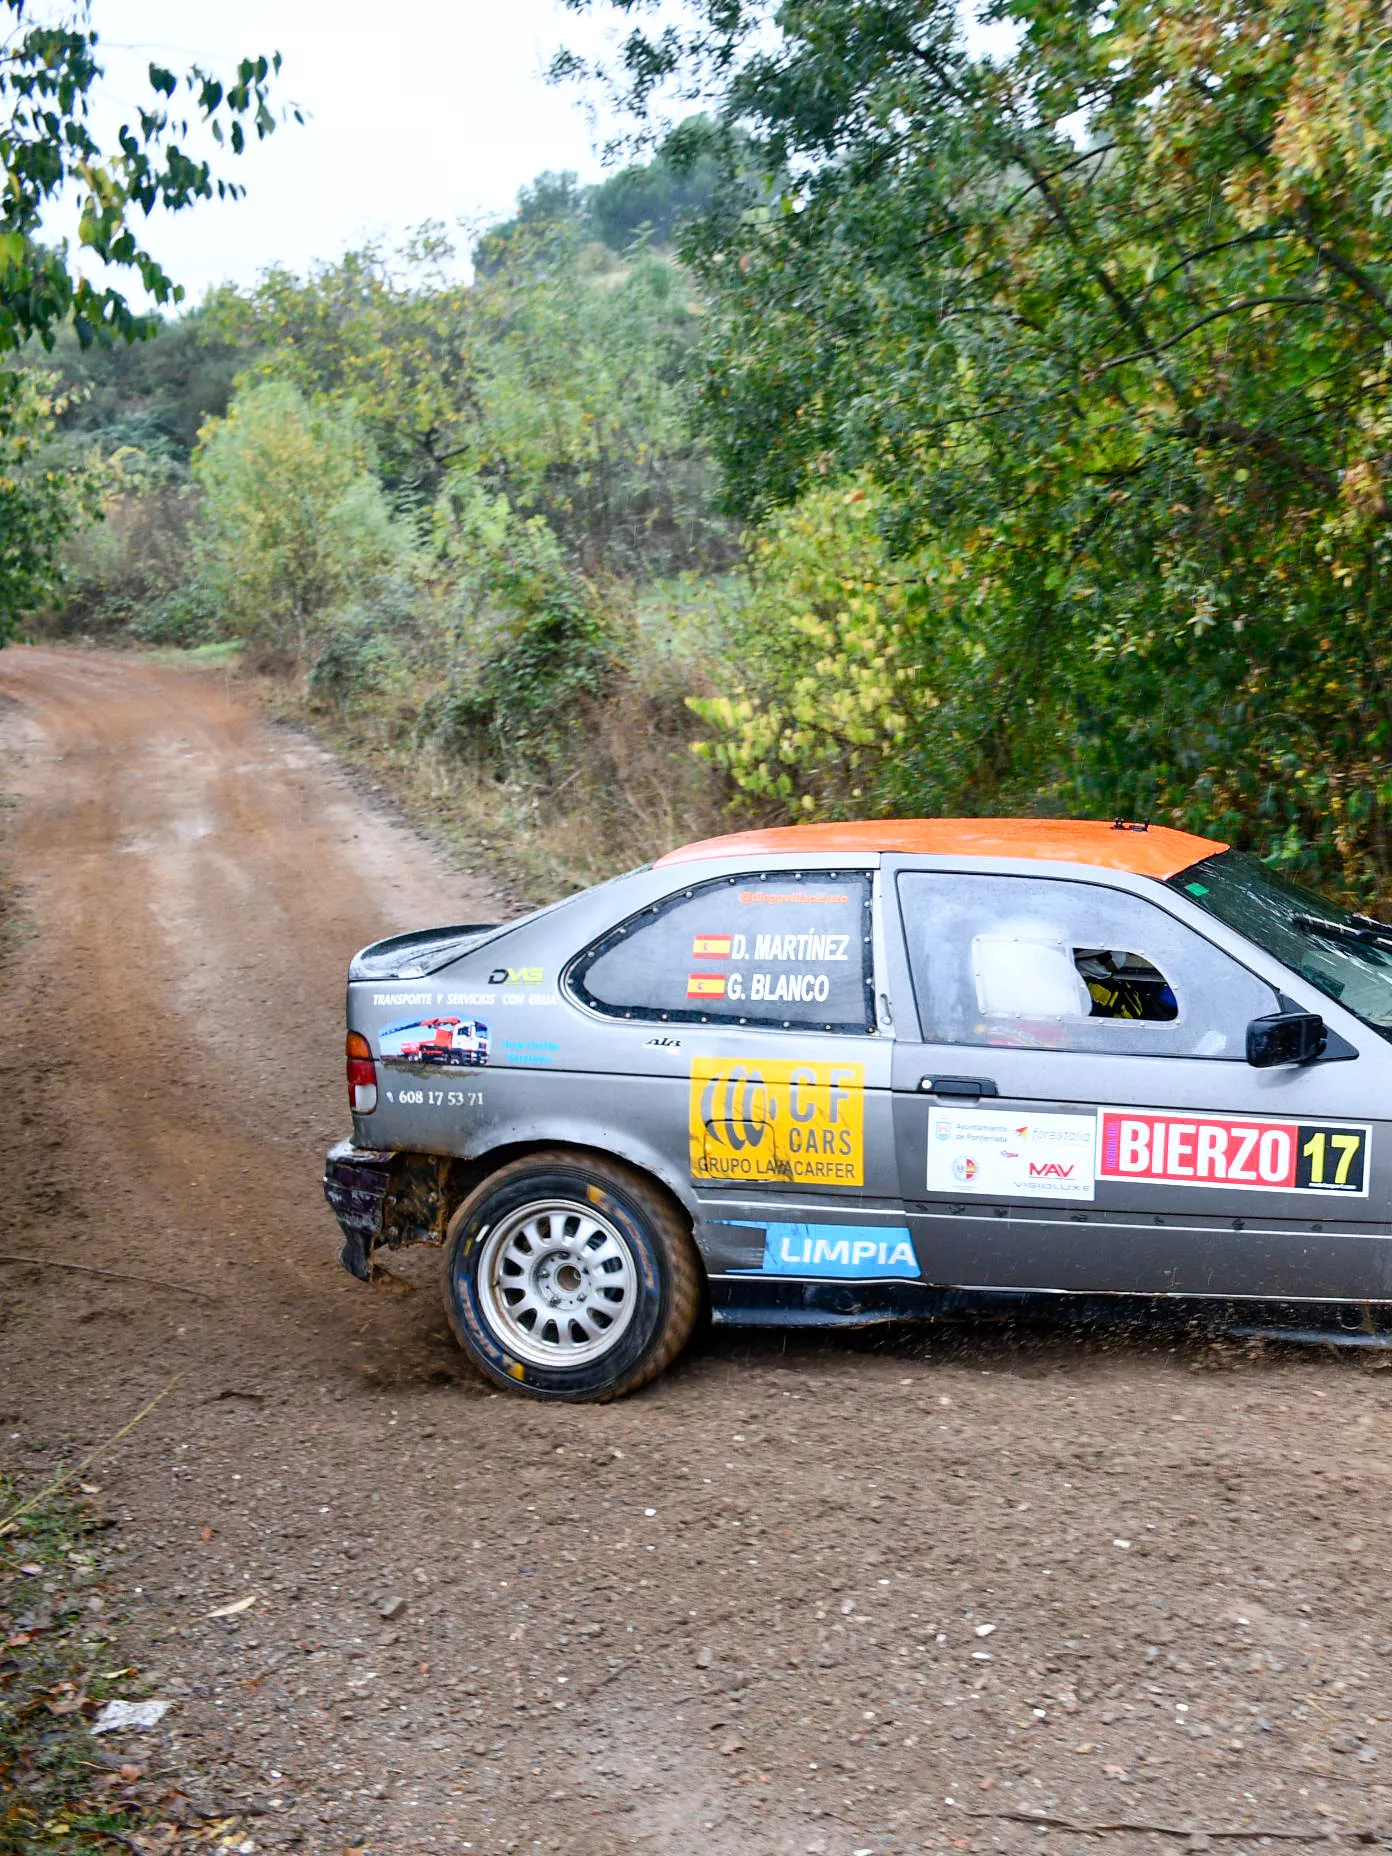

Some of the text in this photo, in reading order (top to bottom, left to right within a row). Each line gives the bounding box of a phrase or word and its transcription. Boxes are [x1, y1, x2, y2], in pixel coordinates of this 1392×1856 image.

[731, 927, 850, 961] D. MARTÍNEZ
[373, 994, 432, 1006] TRANSPORTE
[436, 994, 443, 1004] Y
[447, 994, 496, 1005] SERVICIOS
[502, 994, 524, 1005] CON
[727, 972, 830, 1002] G. BLANCO
[399, 1091, 484, 1106] 608 17 53 71
[789, 1066, 857, 1124] CF
[789, 1127, 852, 1156] CARS
[1118, 1119, 1291, 1183] BIERZO
[697, 1156, 752, 1174] GRUPO
[1029, 1162, 1075, 1178] MAV
[1302, 1132, 1361, 1185] 17
[781, 1237, 917, 1267] LIMPIA
